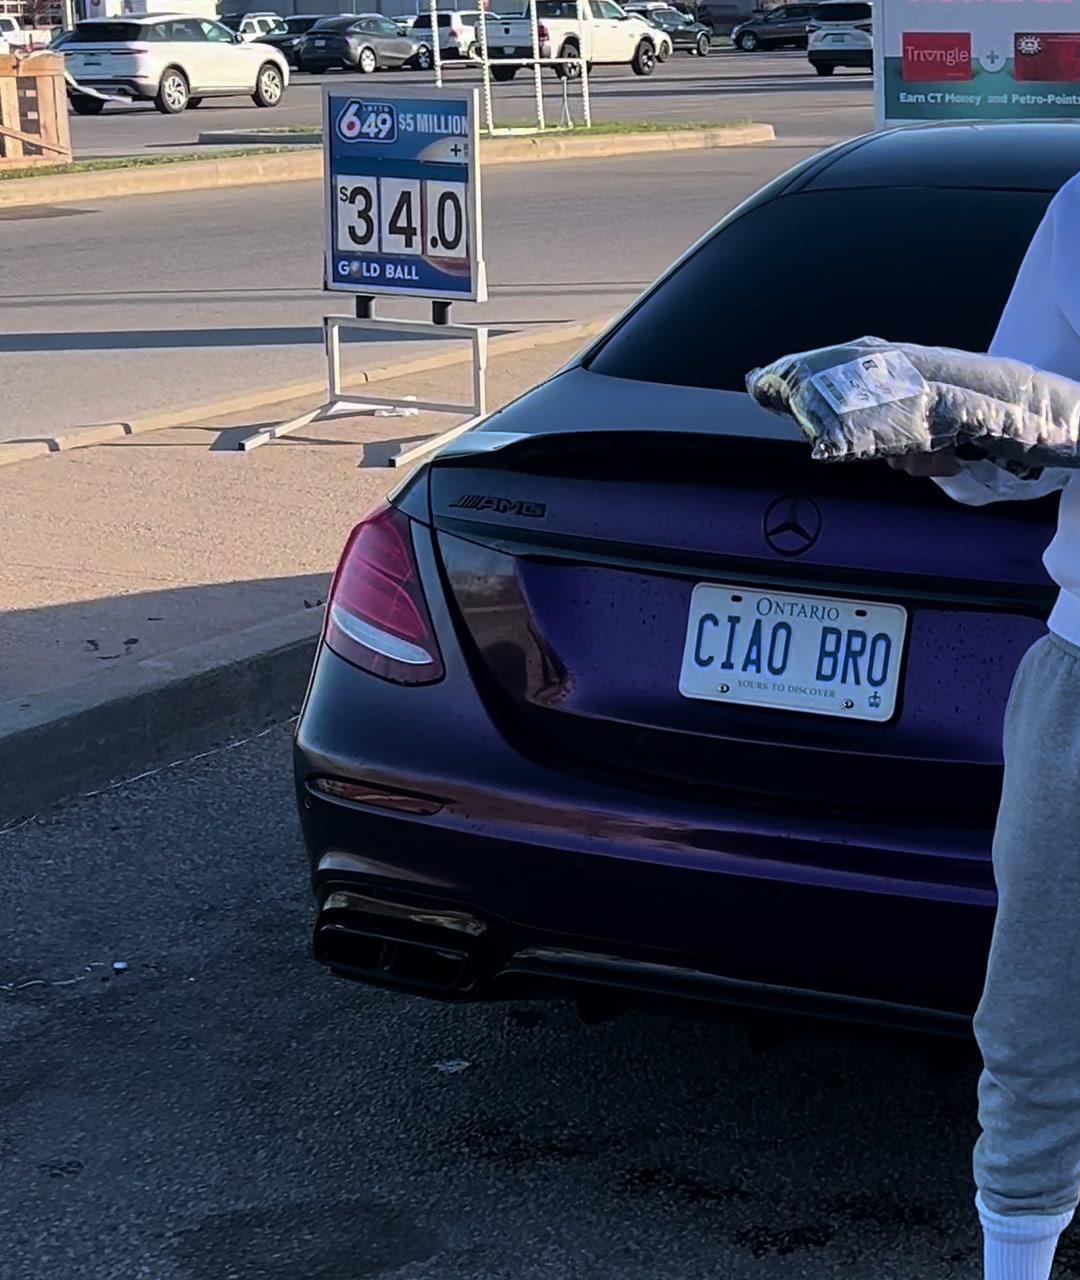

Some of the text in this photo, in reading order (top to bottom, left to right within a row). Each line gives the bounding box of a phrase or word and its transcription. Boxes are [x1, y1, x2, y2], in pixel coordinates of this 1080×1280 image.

[899, 92, 925, 104] Earn
[927, 92, 942, 104] CT
[987, 93, 1008, 105] and
[398, 112, 469, 135] $5 MILLION
[385, 263, 420, 281] BALL
[476, 495, 547, 518] AMG
[756, 597, 840, 624] ONTARIO
[694, 613, 892, 688] CIAO BRO
[737, 679, 836, 699] YOURS TO DISCOVER
